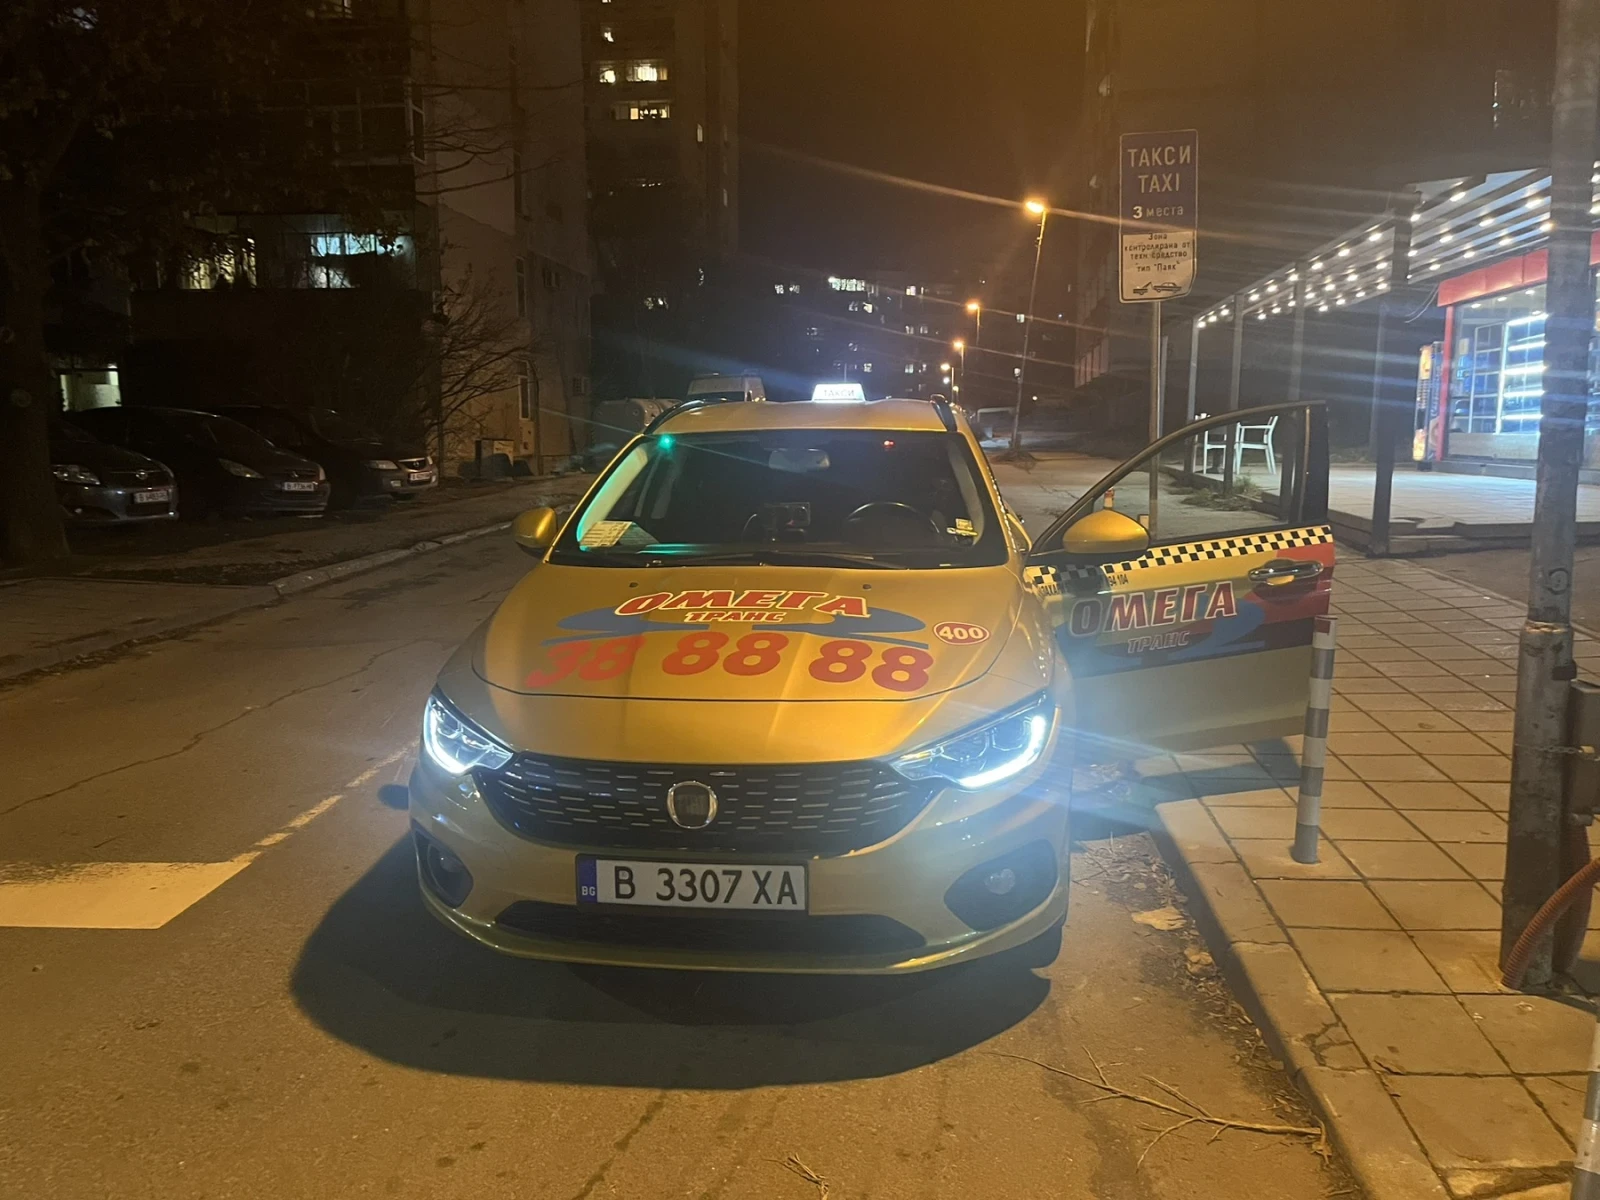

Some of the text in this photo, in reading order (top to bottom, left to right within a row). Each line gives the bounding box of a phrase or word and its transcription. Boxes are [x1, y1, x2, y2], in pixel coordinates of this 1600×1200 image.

[1127, 145, 1191, 168] ТАКСИ
[1138, 173, 1180, 194] TAXI
[1132, 204, 1184, 219] 3 места
[1148, 232, 1168, 241] Зона
[1181, 241, 1191, 249] от
[613, 589, 871, 618] ОМЕГА
[1069, 581, 1238, 637] ОМЕГА
[683, 610, 785, 624] ТРАНС
[939, 625, 984, 640] 400
[1127, 629, 1191, 654] ТРАНС
[525, 631, 935, 693] 38 88 88
[581, 885, 596, 897] BG
[614, 865, 636, 900] B
[655, 867, 743, 904] 3307
